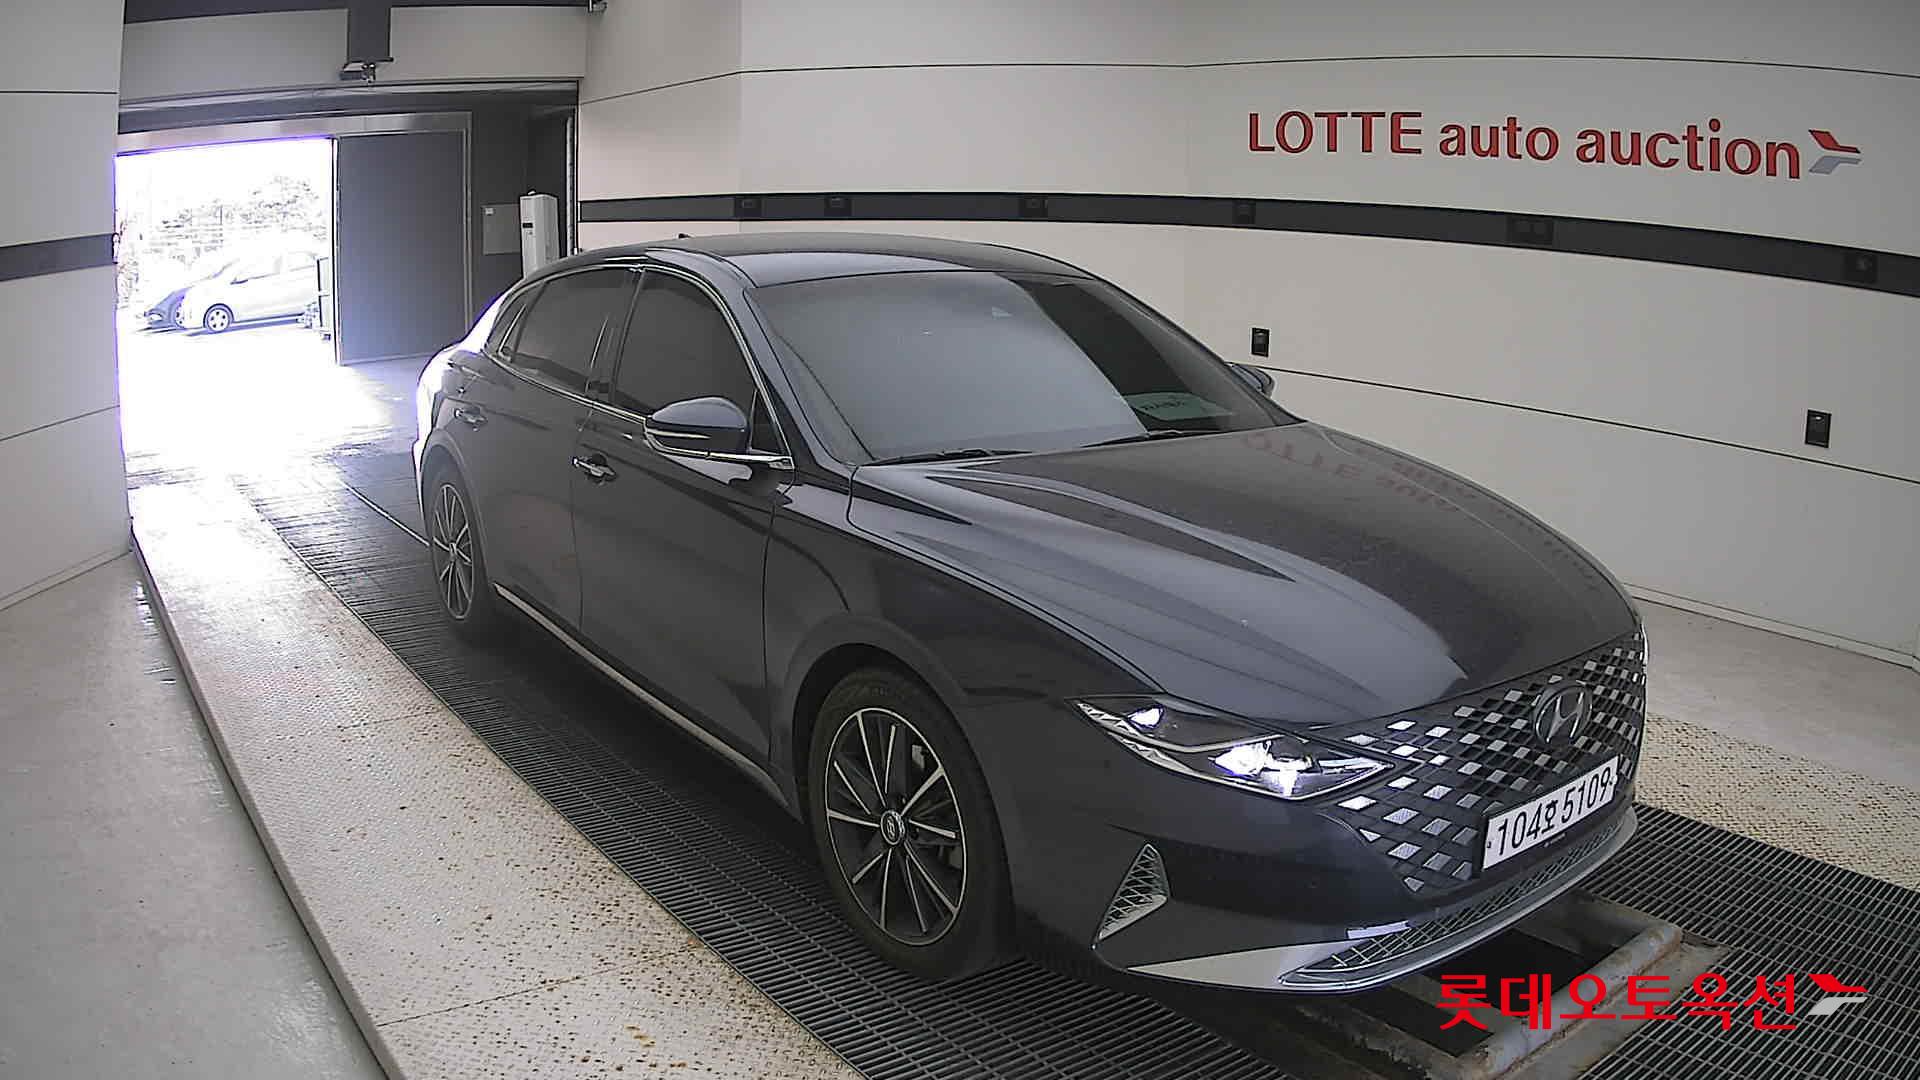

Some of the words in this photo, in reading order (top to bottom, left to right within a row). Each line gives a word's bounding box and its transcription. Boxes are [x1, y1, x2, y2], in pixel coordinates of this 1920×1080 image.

[1248, 111, 1422, 155] LOTTE
[1439, 115, 1560, 161] auto
[1575, 118, 1801, 179] auction
[1498, 799, 1558, 856] 104호
[1561, 766, 1611, 823] 5109
